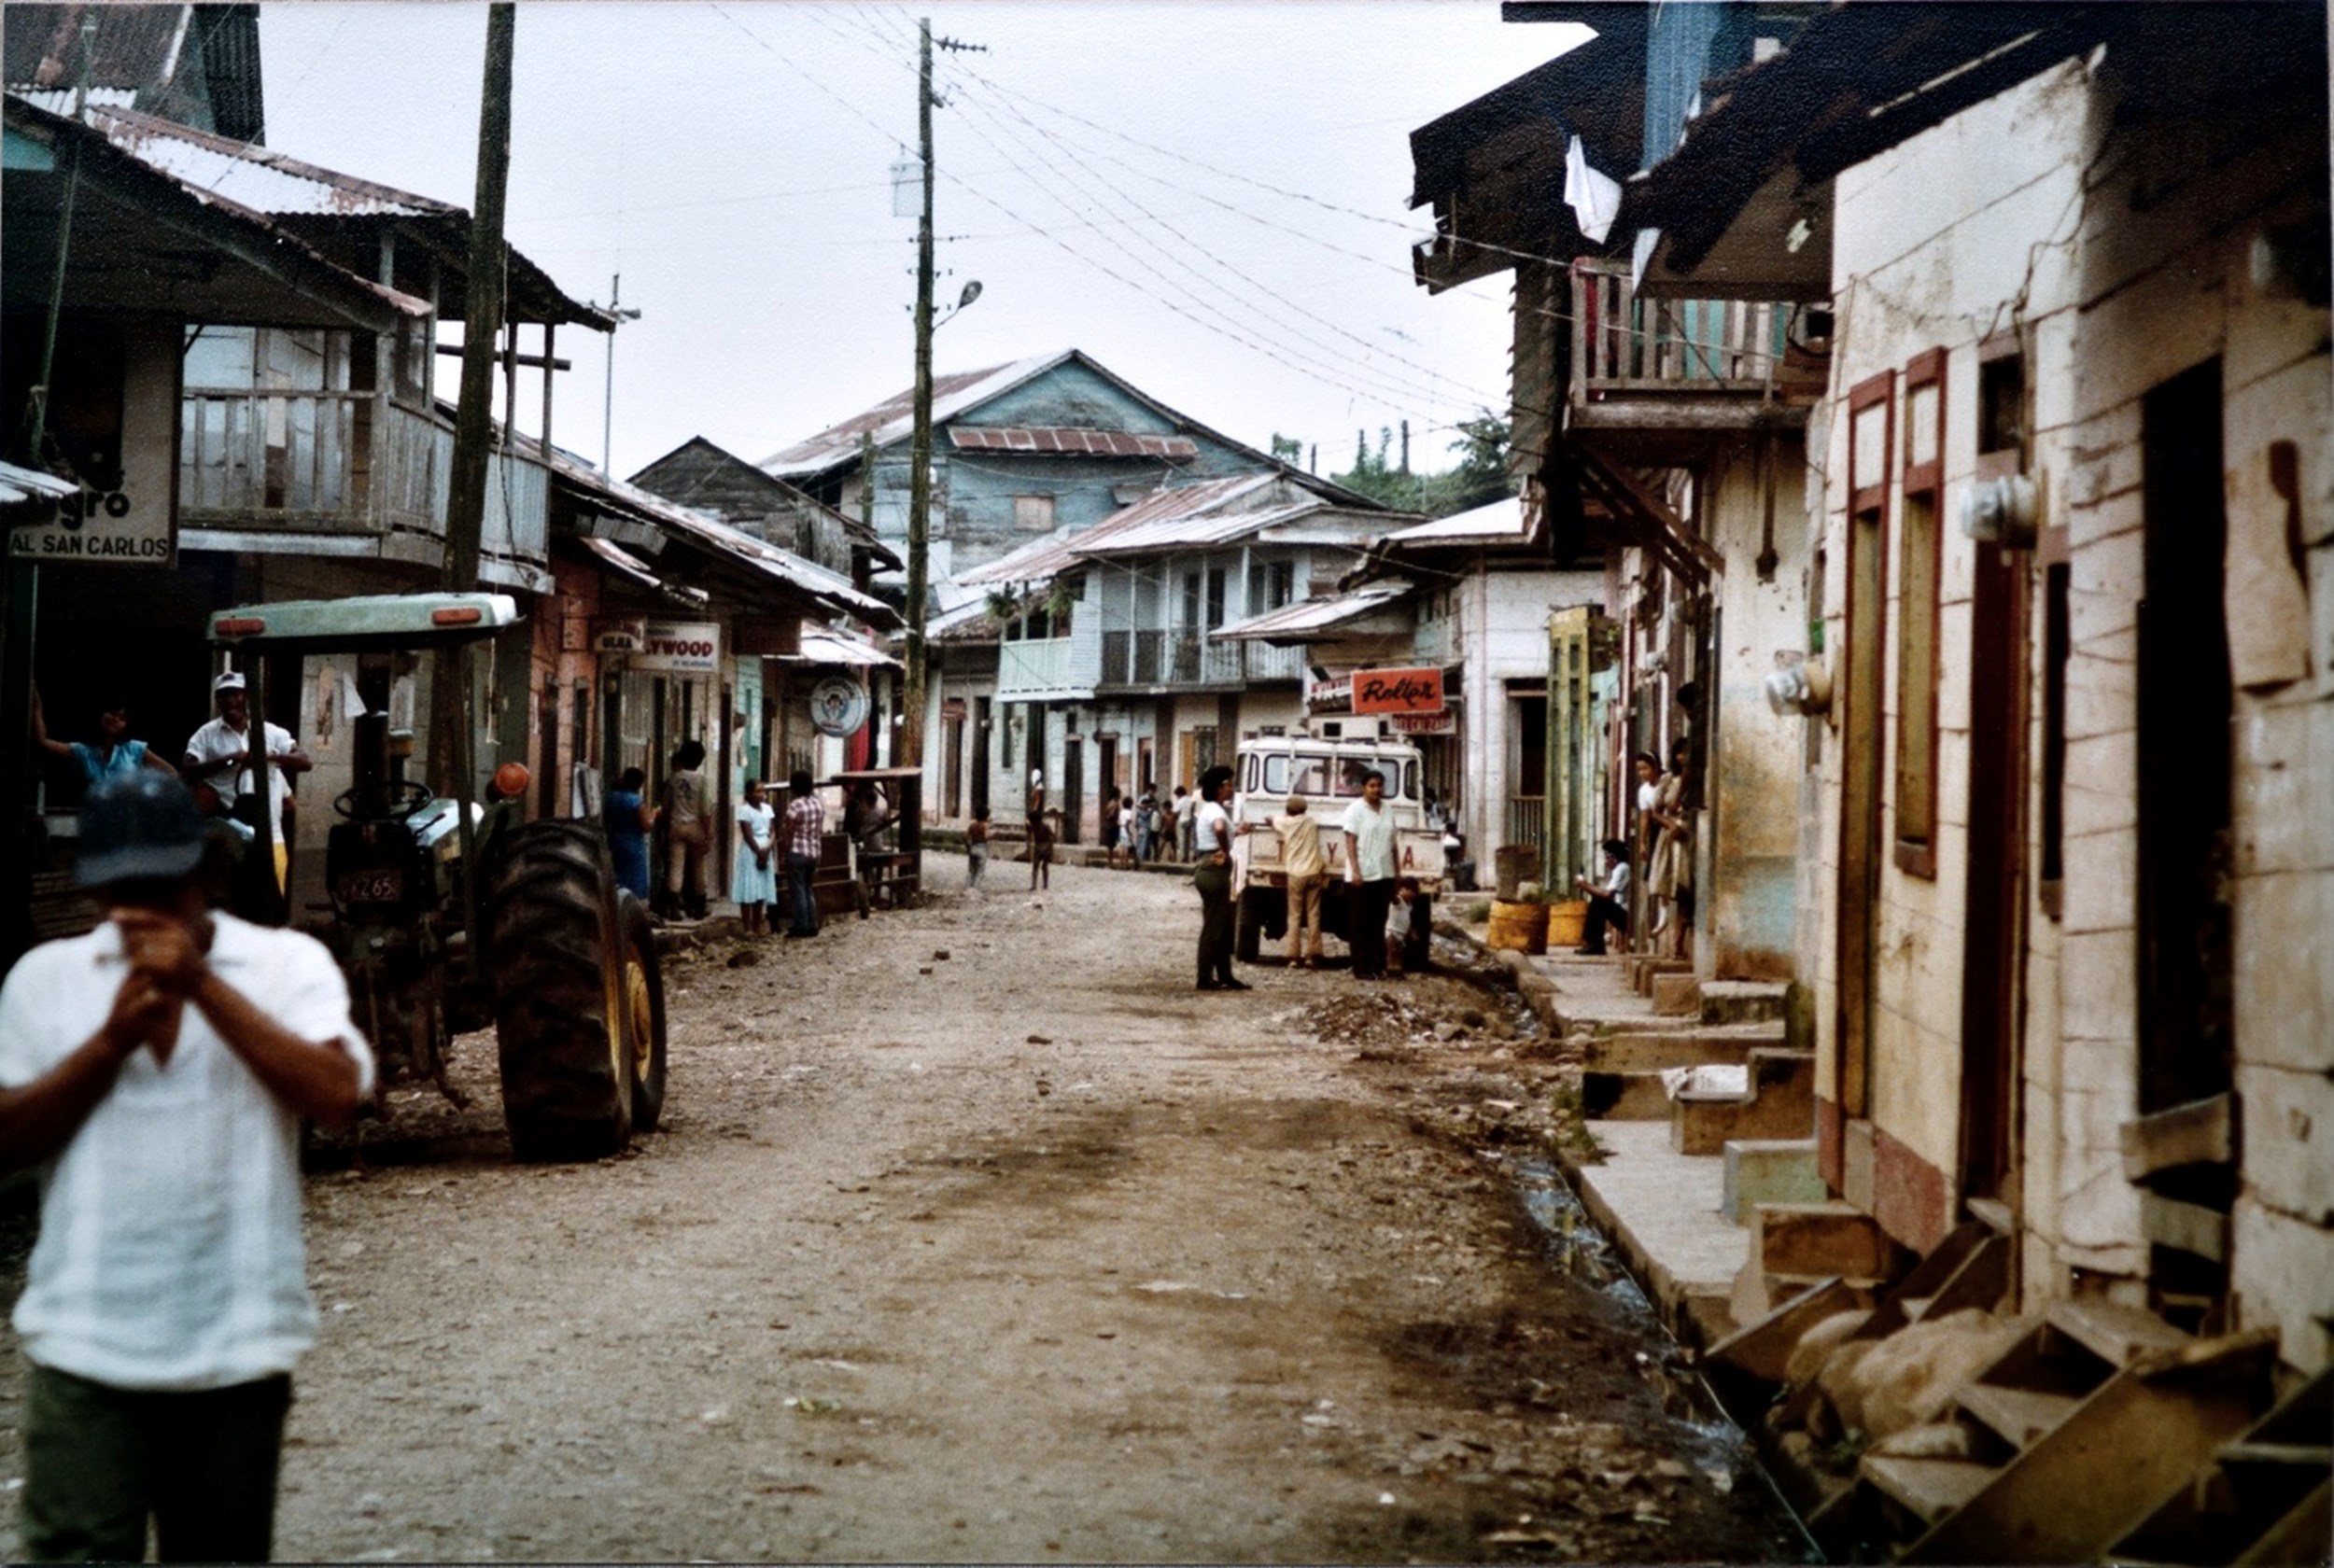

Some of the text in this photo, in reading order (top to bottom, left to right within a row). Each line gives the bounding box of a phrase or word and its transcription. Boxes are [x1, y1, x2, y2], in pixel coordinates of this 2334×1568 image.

[43, 535, 81, 553] SAN
[88, 537, 167, 556] CARLOS
[646, 639, 713, 657] YWOOD
